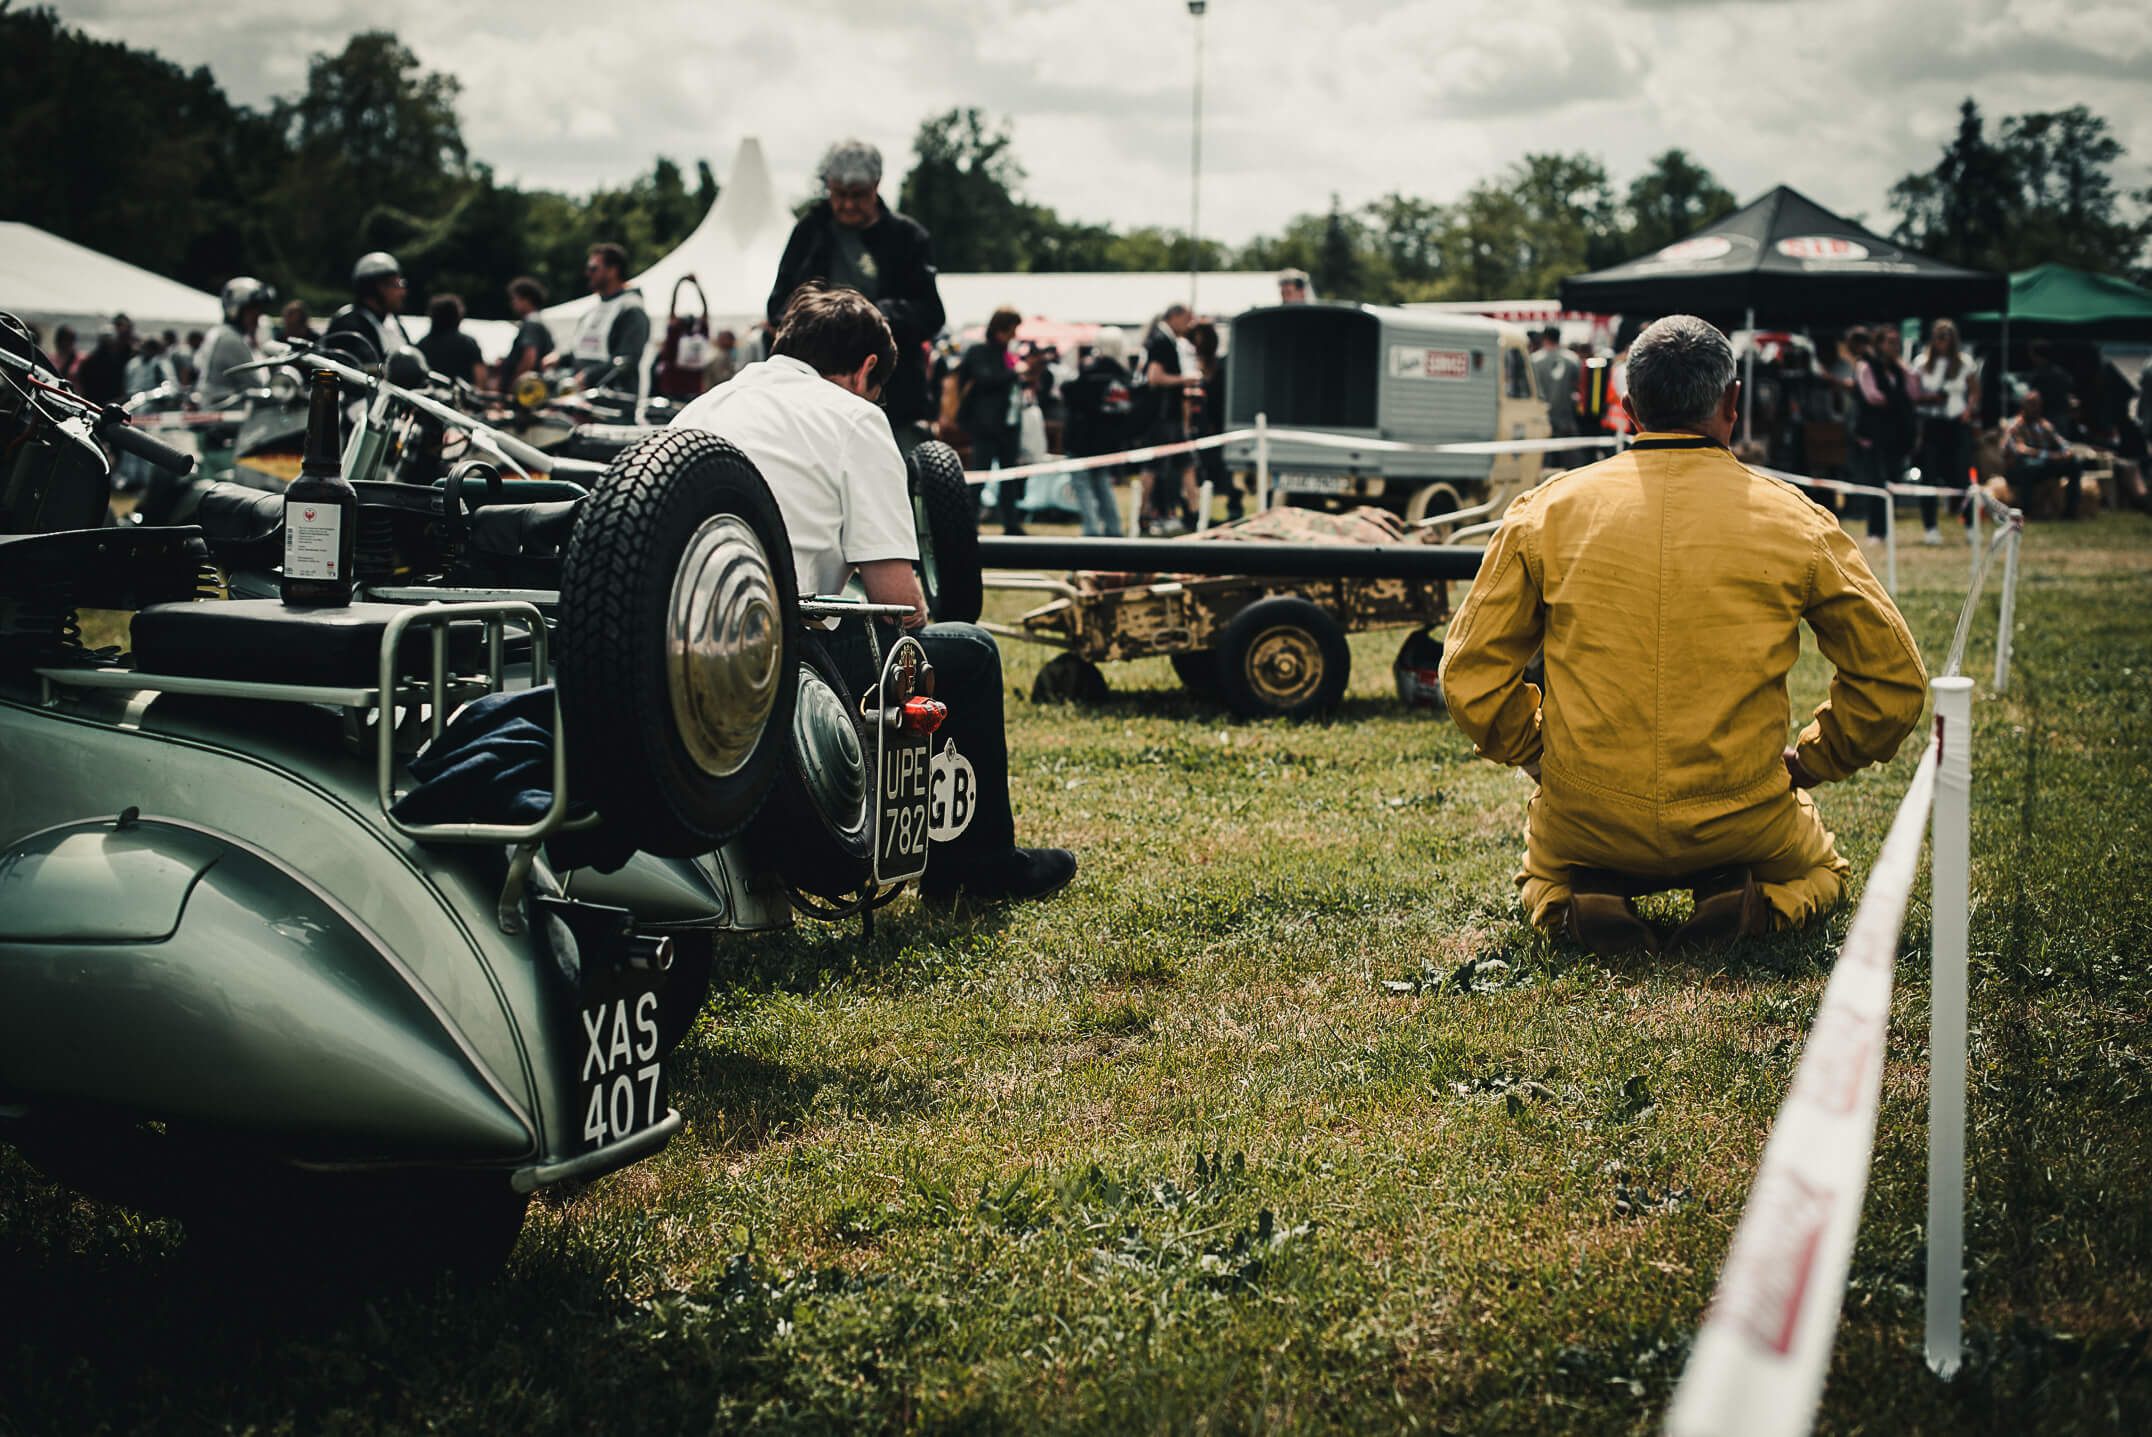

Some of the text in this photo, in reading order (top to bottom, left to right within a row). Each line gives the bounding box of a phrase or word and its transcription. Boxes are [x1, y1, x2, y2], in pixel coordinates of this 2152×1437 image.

[886, 746, 927, 800] UPE
[929, 768, 969, 829] GB
[884, 804, 925, 859] 782
[582, 991, 658, 1082] XAS
[584, 1063, 660, 1148] 407
